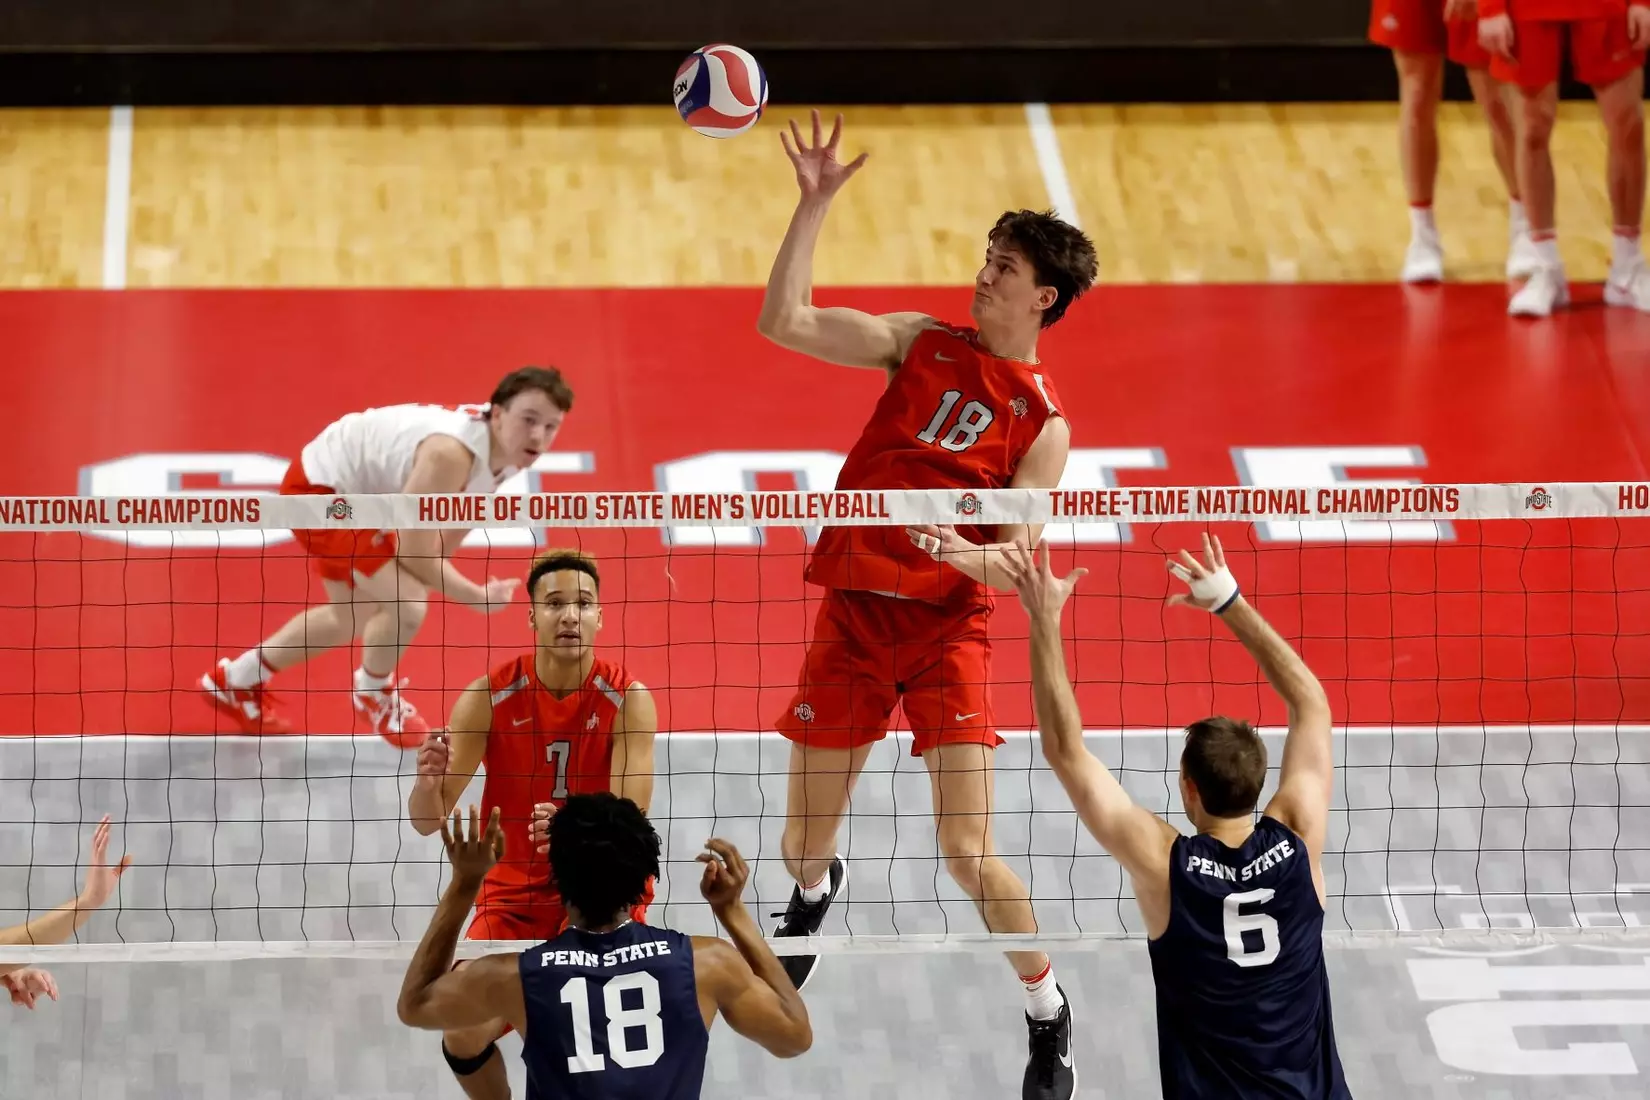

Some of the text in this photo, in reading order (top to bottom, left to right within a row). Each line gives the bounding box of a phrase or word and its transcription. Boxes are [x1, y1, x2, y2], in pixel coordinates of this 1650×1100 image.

[915, 388, 995, 453] 18
[0, 498, 260, 524] NATIONAL CHAMPIONS
[419, 493, 890, 522] HOME OF OHIO STATE MEN'S VOLLEYBALL
[1049, 487, 1460, 516] THREE-TIME NATIONAL CHAMPIONS
[546, 740, 571, 799] 7
[1186, 839, 1295, 882] PENN STATE
[1223, 888, 1281, 967] 6
[541, 940, 671, 968] PENN STATE
[560, 970, 665, 1074] 18
